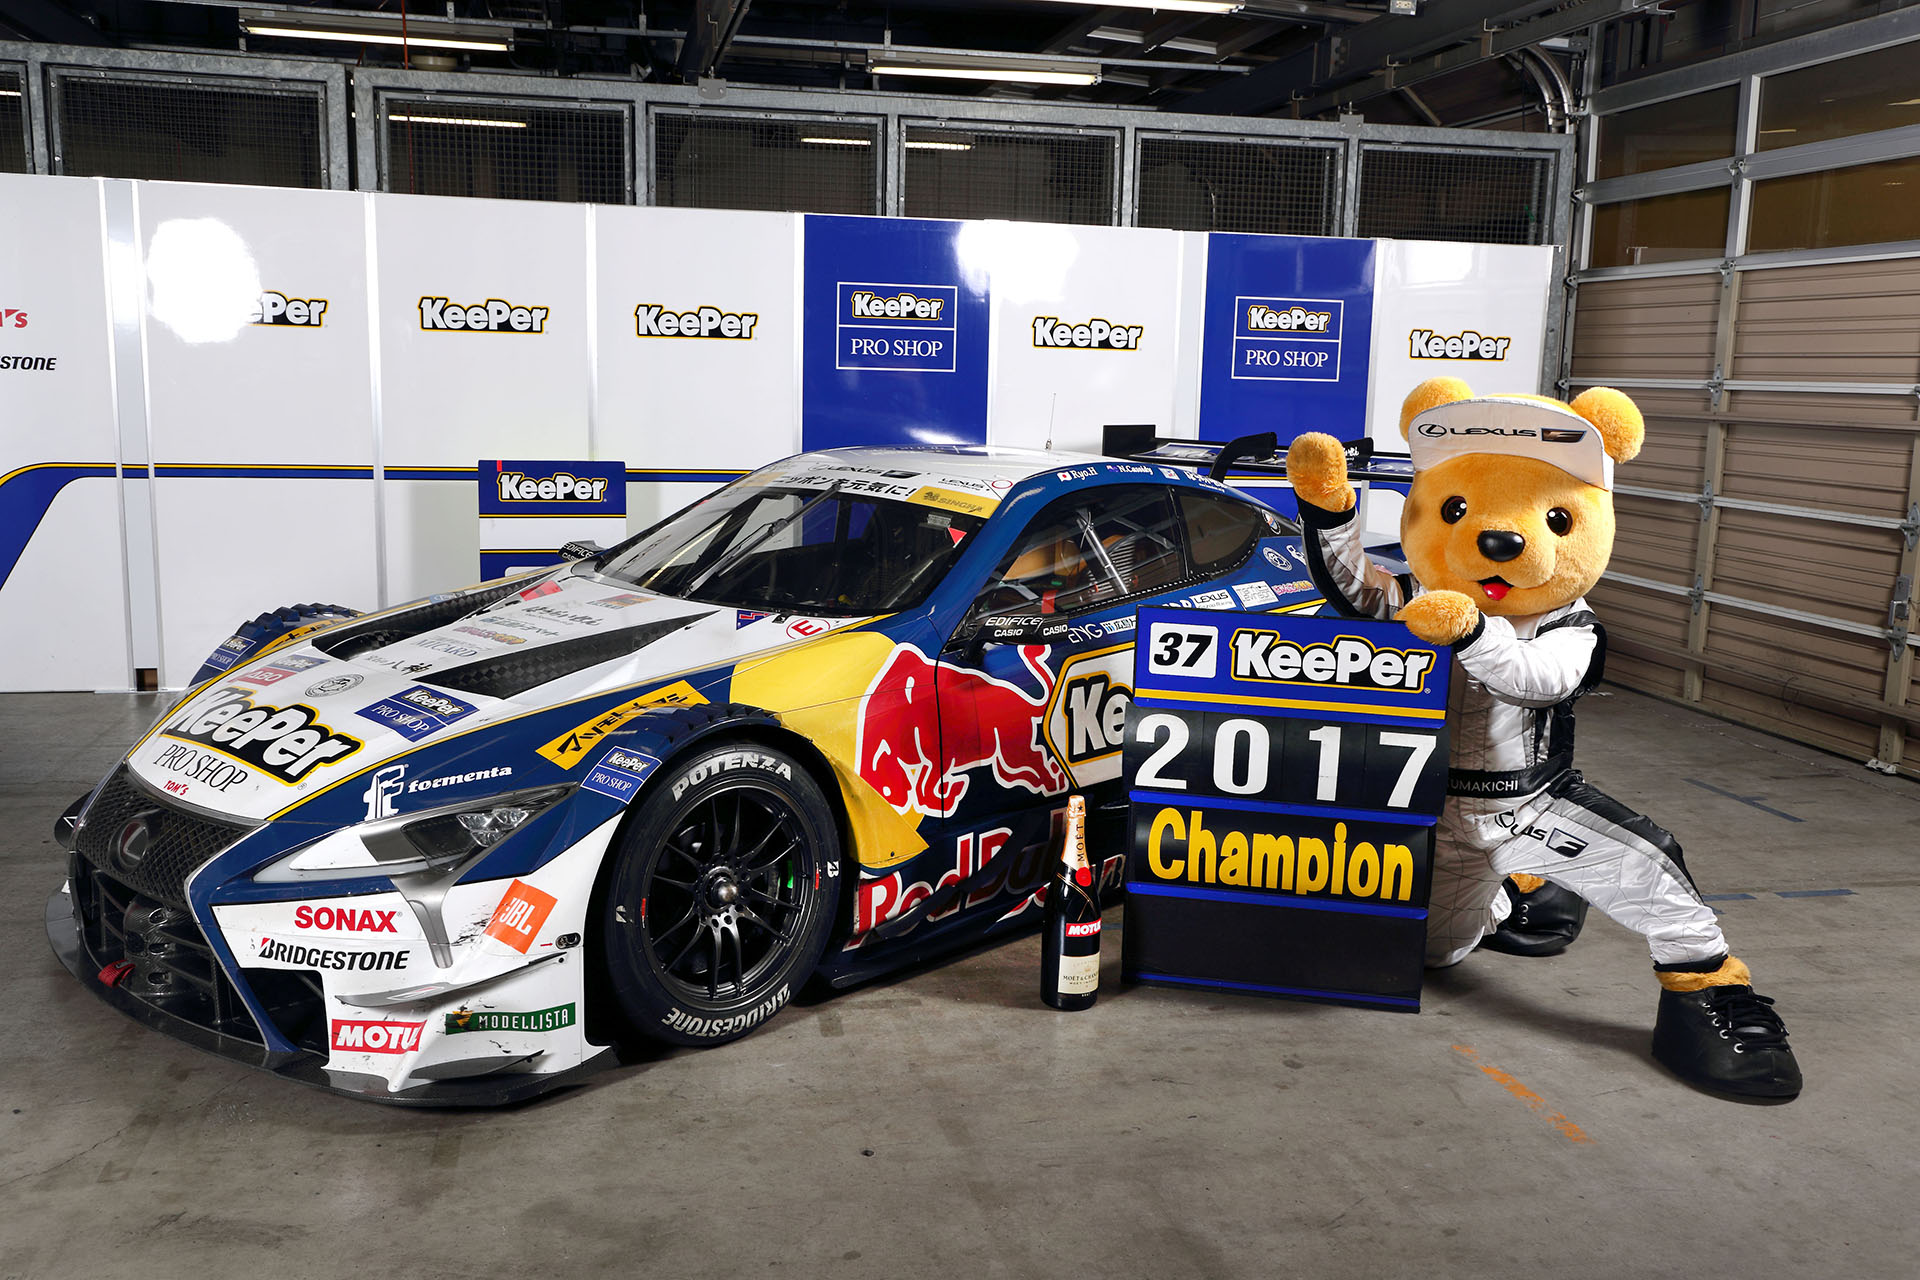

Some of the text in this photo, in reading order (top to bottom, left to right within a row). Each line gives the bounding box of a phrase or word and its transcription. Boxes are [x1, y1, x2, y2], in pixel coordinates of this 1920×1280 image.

[248, 292, 325, 325] ePer
[421, 298, 548, 332] KeePer
[853, 293, 943, 318] KeePer
[636, 306, 757, 338] KeePer
[1249, 307, 1330, 332] KeePer
[1033, 318, 1143, 349] KeePer
[1410, 331, 1510, 360] KeePer
[851, 338, 943, 357] PRO SHOP
[1245, 350, 1329, 367] PRO SHOP
[1450, 427, 1537, 437] LEXUS
[500, 474, 606, 500] KeePer
[1194, 590, 1229, 604] LEXUS
[985, 616, 1042, 627] EDIFICE
[994, 628, 1023, 637] CASIO
[1043, 624, 1068, 636] CASIO
[1153, 632, 1432, 688] 37 KeePer
[403, 689, 462, 716] KeePer
[371, 704, 430, 733] PRO SHOP
[171, 692, 351, 778] KeePer
[153, 743, 249, 793] PRO SHOP
[609, 752, 649, 772] KeePer
[592, 772, 633, 791] PRO SHOP
[672, 751, 793, 802] POTENZA
[1448, 779, 1518, 792] UMAKICHI
[1148, 807, 1414, 901] Champion
[295, 906, 398, 933] SONAX
[500, 897, 532, 935] JBL
[1068, 920, 1101, 938] MOTU
[259, 938, 410, 971] BRIDGESTONE
[478, 1008, 569, 1029] MODELLISTA
[661, 983, 791, 1038] BRIDGESTONE
